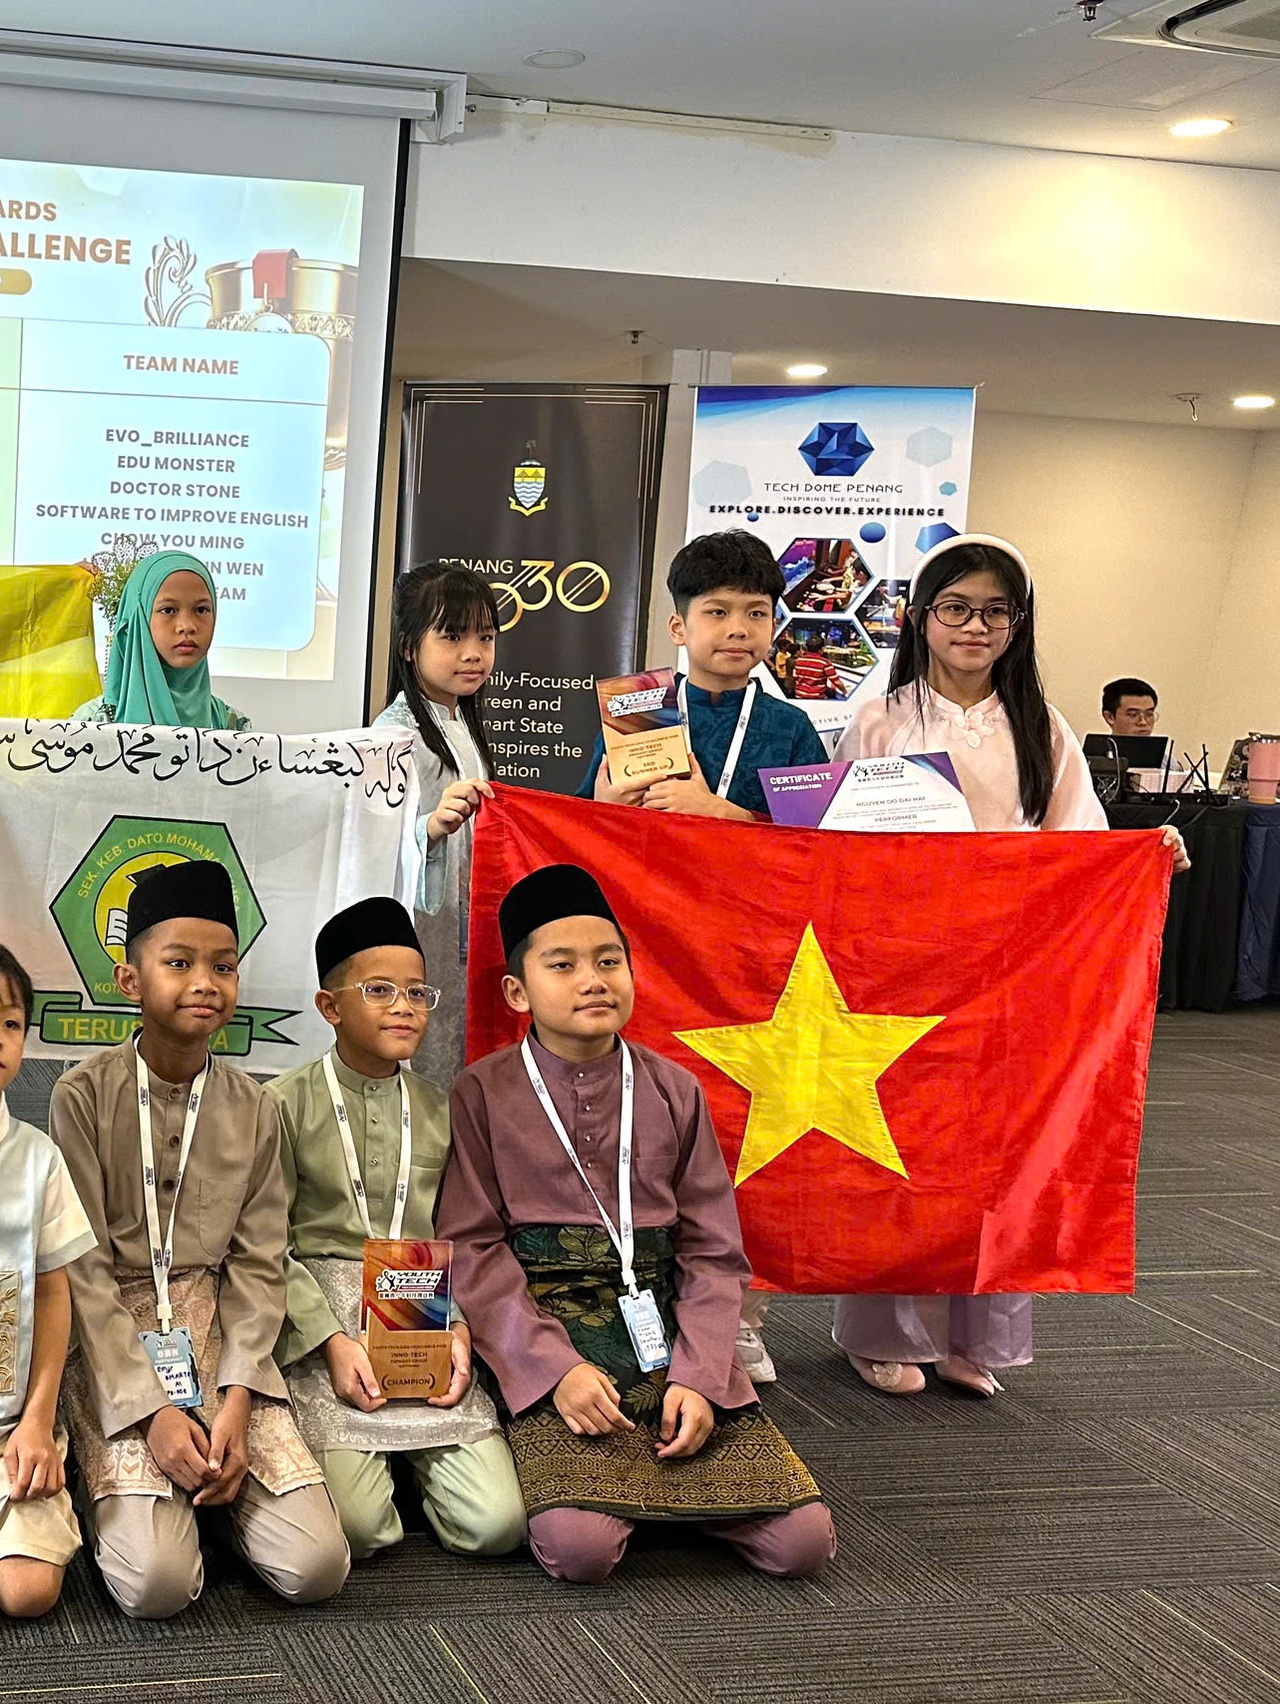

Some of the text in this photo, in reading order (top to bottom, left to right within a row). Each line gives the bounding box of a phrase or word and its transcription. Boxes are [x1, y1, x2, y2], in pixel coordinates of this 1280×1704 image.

[123, 354, 239, 375] TEAM NAME
[106, 429, 250, 448] EVO_BRILLIANCE
[117, 455, 236, 473] EDU MONSTER
[110, 481, 241, 499] DOCTOR STONE
[764, 482, 903, 494] TECH DOME PENANG
[36, 504, 309, 529] SOFTWARE TO IMPROVE ENGLISH
[160, 534, 196, 548] YOU
[200, 535, 245, 550] MING
[226, 561, 264, 577] WEN
[485, 696, 561, 711] reen and
[483, 717, 564, 733] mart State
[488, 740, 582, 758] nspires the
[494, 761, 540, 778] ation
[769, 771, 833, 785] CERTIFICATE
[127, 833, 163, 850] DATO
[166, 833, 220, 862] MOHAM
[93, 981, 121, 994] KOT
